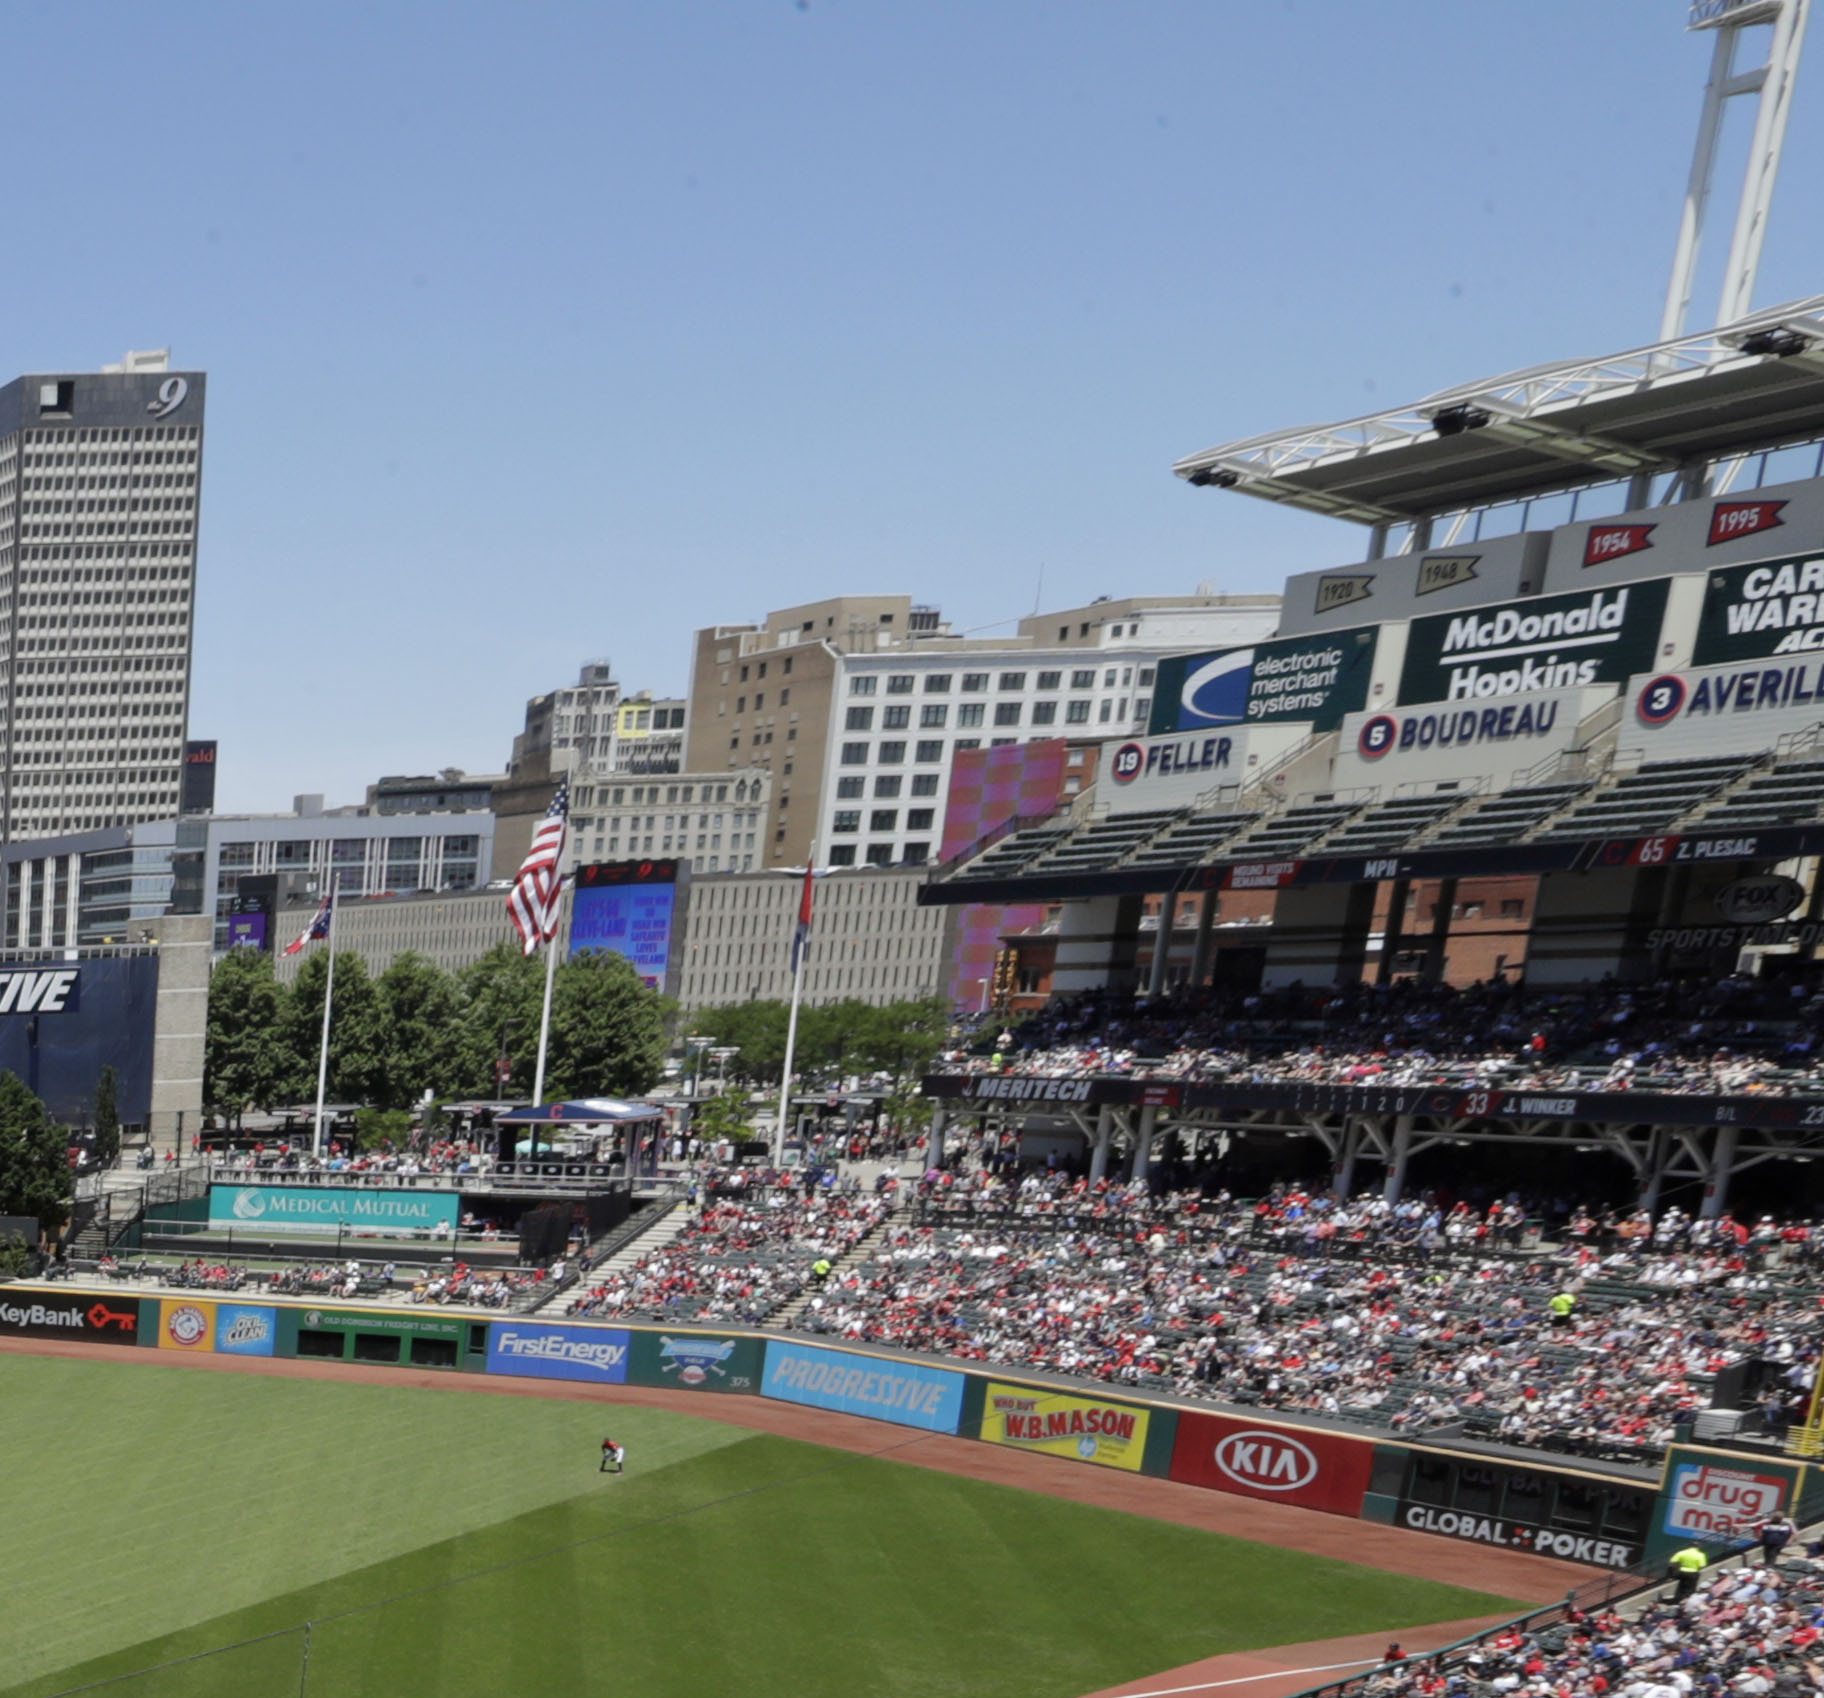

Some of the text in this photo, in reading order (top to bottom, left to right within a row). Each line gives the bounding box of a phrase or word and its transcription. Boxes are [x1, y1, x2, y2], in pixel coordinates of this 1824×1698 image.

[1718, 507, 1760, 532] 1995
[1592, 530, 1631, 555] 1954
[1424, 562, 1459, 583] 1948
[1323, 581, 1354, 602] 1920
[1442, 588, 1629, 652] McDonald
[1254, 647, 1342, 676] electronic
[1251, 667, 1339, 697] merchant
[1448, 656, 1598, 701] Hopkins
[1247, 692, 1326, 719] systems
[1652, 687, 1671, 710] 3
[1369, 700, 1558, 750] 5 BOUDREAU
[1117, 737, 1232, 774] 19 FELLER
[1364, 860, 1397, 878] MPH
[1731, 883, 1780, 911] FOX
[1646, 928, 1735, 950] SPORTS
[976, 1078, 1092, 1101] MERITECH
[1465, 1093, 1488, 1115] 33
[1519, 1098, 1577, 1115] WINKER
[268, 1195, 431, 1219] MEDICAL MUTUAL
[496, 1331, 626, 1364] FirstEnergy
[729, 1375, 750, 1388] 375
[772, 1357, 948, 1416] PROGRESSIVE
[1229, 1440, 1301, 1480] KIA
[1707, 1467, 1756, 1481] DISCOUNT
[1681, 1474, 1763, 1515] drug
[1406, 1505, 1629, 1568] GLOBAL POKER
